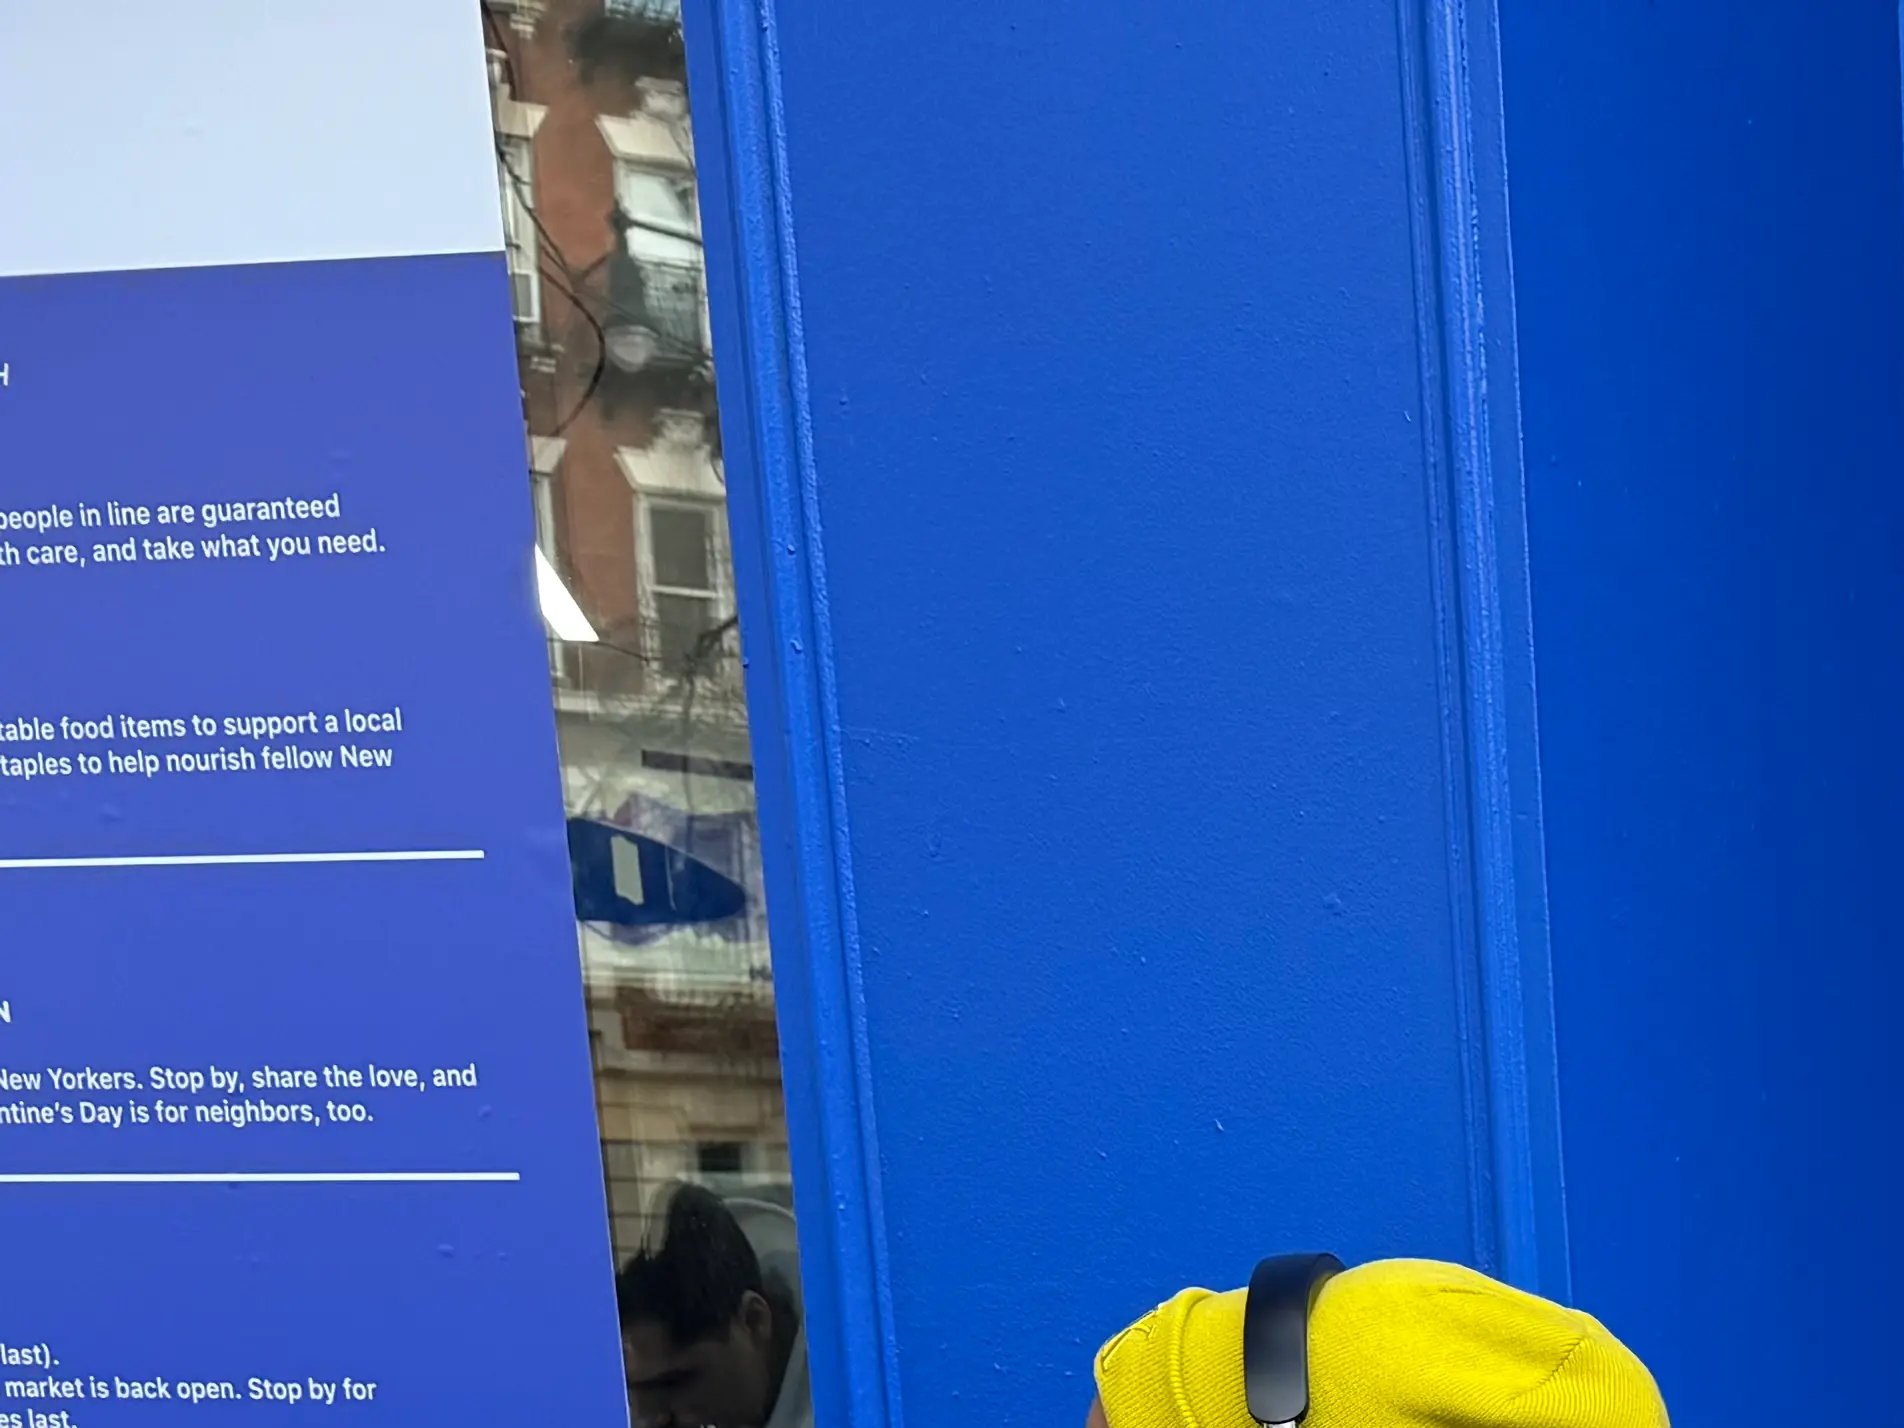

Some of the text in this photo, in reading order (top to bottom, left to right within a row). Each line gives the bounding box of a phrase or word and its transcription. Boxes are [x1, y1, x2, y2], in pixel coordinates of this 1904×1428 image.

[79, 503, 101, 526] in
[108, 501, 150, 526] line
[157, 505, 194, 524] are
[202, 494, 340, 528] guaranteed
[27, 545, 85, 567] care,
[93, 537, 136, 562] and
[143, 536, 194, 560] take
[201, 534, 260, 558] what
[266, 537, 310, 561] you
[318, 529, 385, 553] need.
[60, 715, 114, 739] food
[120, 715, 186, 738] items
[192, 715, 216, 736] to
[224, 712, 318, 740] support
[325, 715, 338, 732] a
[345, 707, 402, 732] local
[77, 753, 102, 774] to
[108, 749, 159, 777] help
[166, 747, 256, 771] nourish
[261, 745, 332, 769] fellow
[340, 745, 392, 767] New
[47, 1067, 143, 1089] Yorkers.
[150, 1067, 204, 1093] Stop
[210, 1066, 244, 1093] by,
[252, 1066, 317, 1088] share
[323, 1065, 362, 1087] the
[369, 1064, 425, 1092] love,
[433, 1063, 477, 1086] and
[80, 1102, 122, 1128] Day
[129, 1100, 149, 1123] is
[154, 1100, 188, 1123] for
[195, 1099, 320, 1127] neighbors,
[326, 1101, 373, 1121] too.
[0, 1343, 59, 1369] last).
[5, 1376, 376, 1405] market is back open. Stop by for
